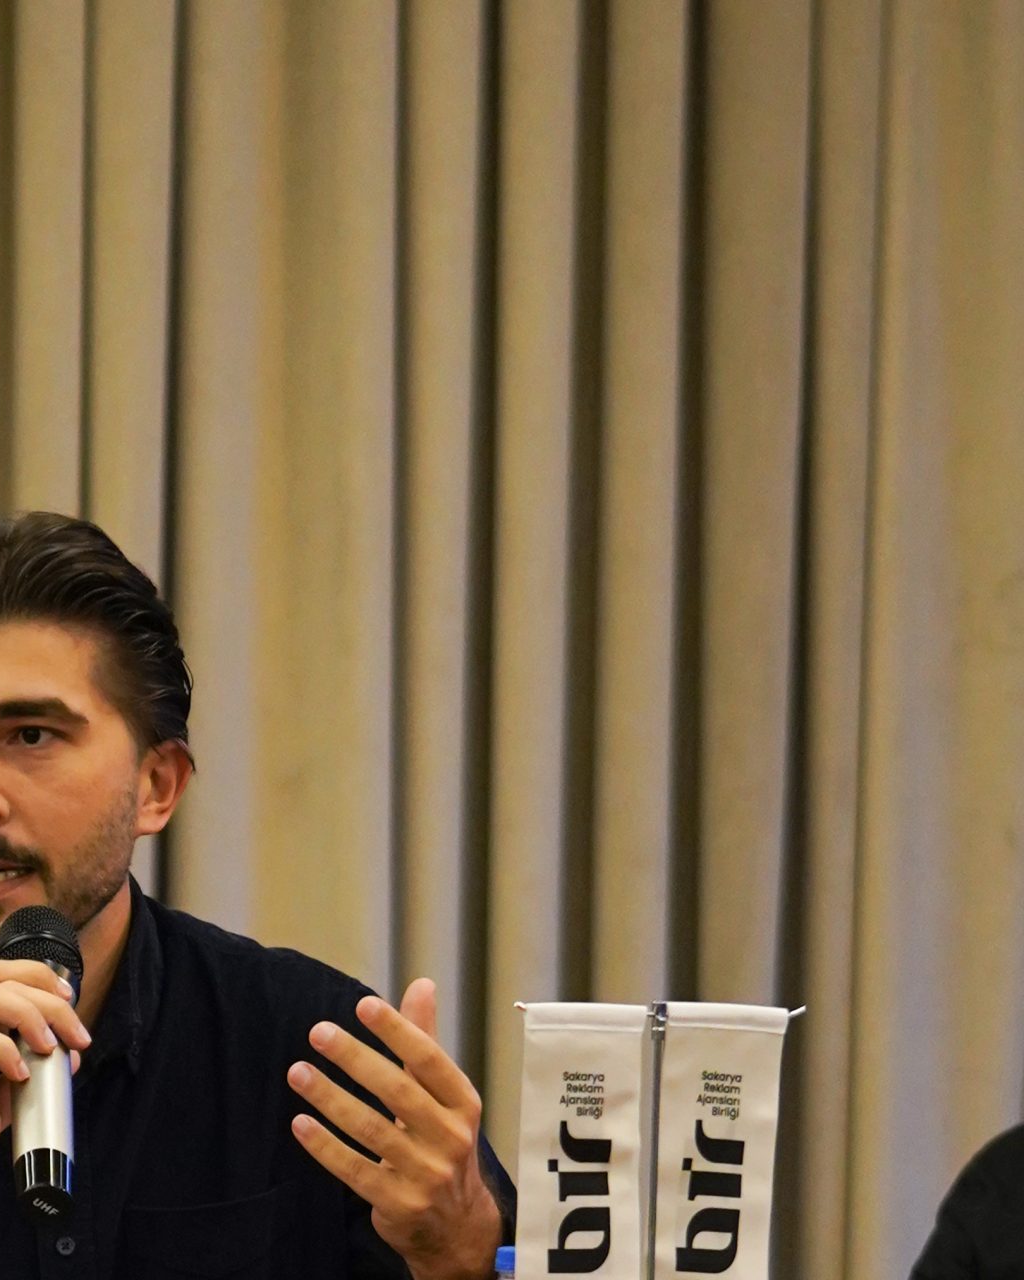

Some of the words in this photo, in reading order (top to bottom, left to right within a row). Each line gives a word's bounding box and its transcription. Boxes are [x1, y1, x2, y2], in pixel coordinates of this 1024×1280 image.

[562, 1071, 605, 1084] Sakarya
[701, 1070, 742, 1084] Sakarya
[566, 1083, 604, 1093] Reklam
[703, 1082, 741, 1094] Reklam
[32, 1198, 60, 1216] UHF
